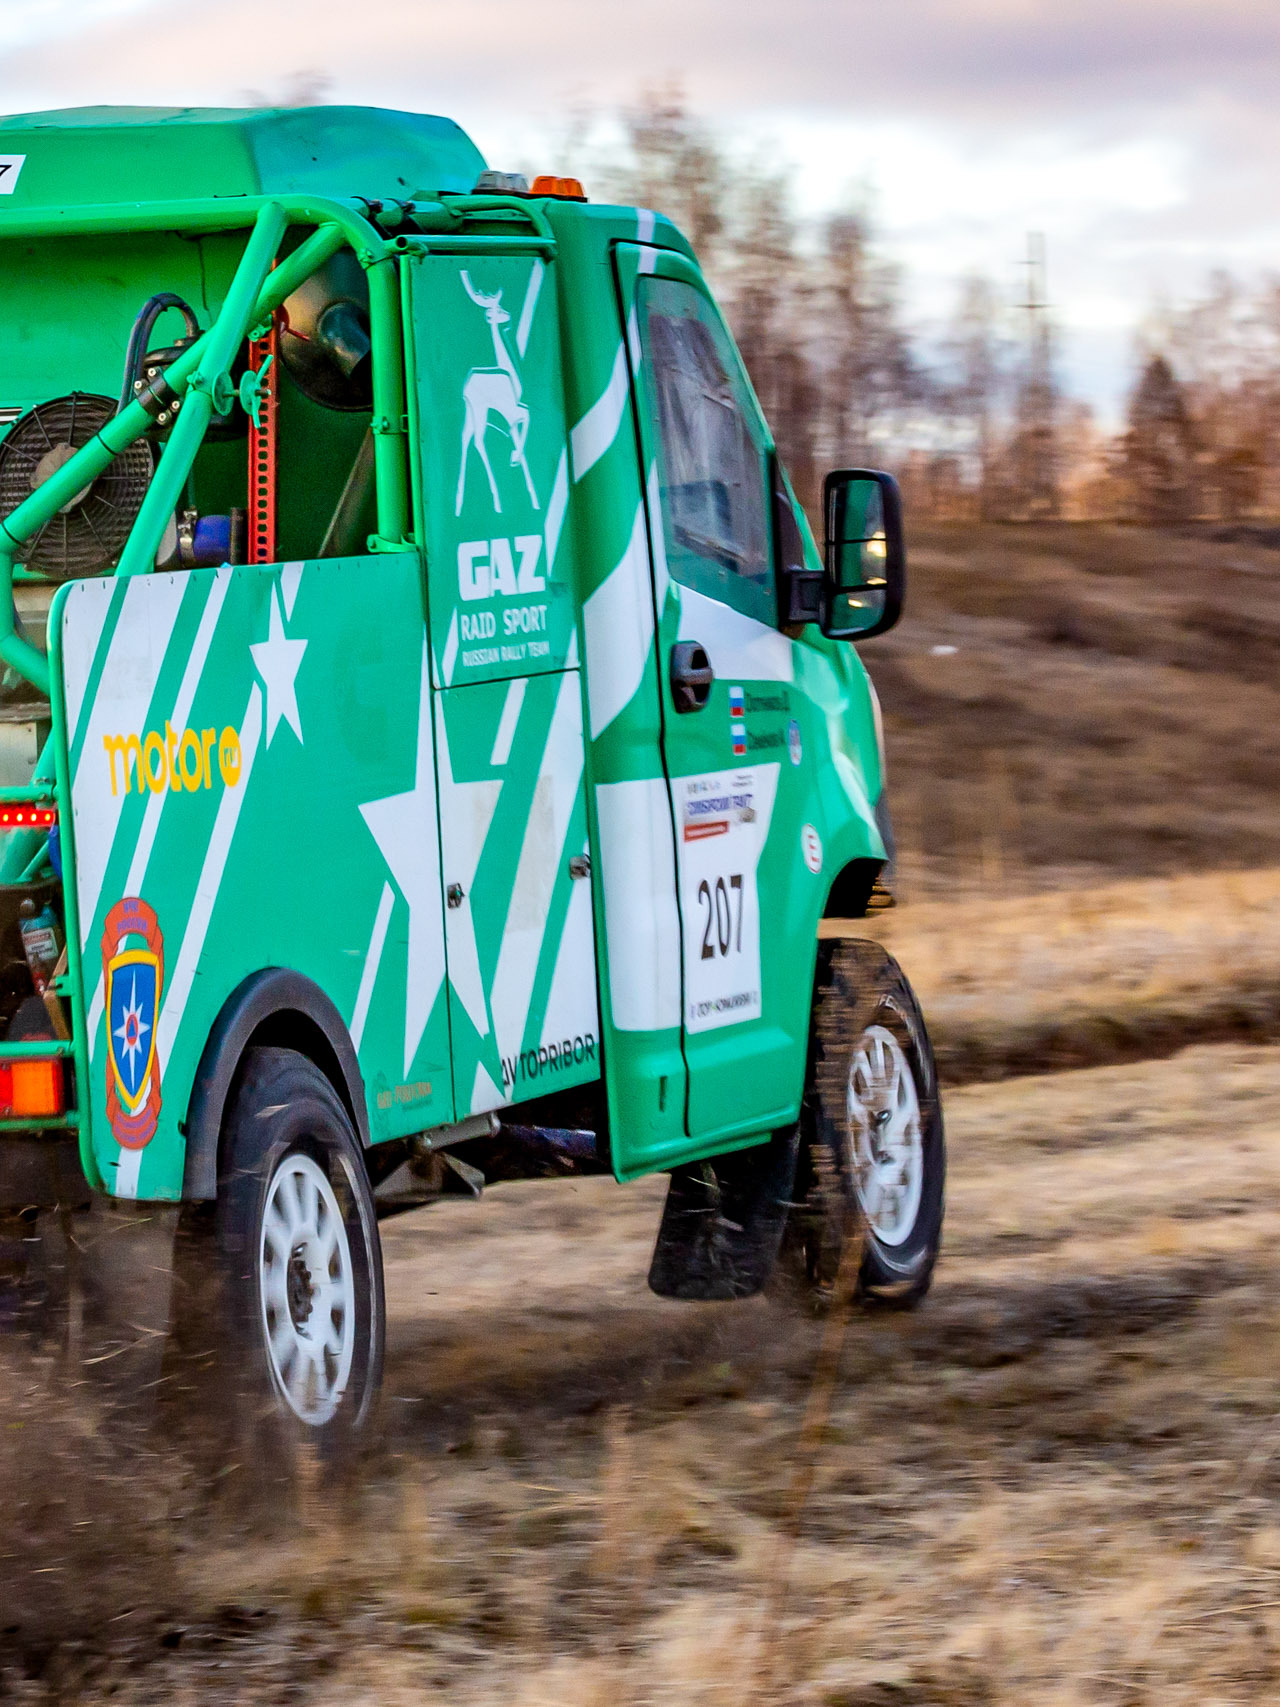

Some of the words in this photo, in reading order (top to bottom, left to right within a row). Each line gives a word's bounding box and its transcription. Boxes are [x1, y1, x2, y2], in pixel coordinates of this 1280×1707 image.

[457, 534, 546, 602] GAZ
[461, 611, 496, 641] RAID
[503, 604, 547, 636] SPORT
[462, 647, 500, 667] RUSSIAN
[500, 643, 527, 662] RALLY
[527, 640, 550, 658] TEAM
[698, 874, 743, 960] 207
[501, 1032, 597, 1087] AVTOPRIBOR
